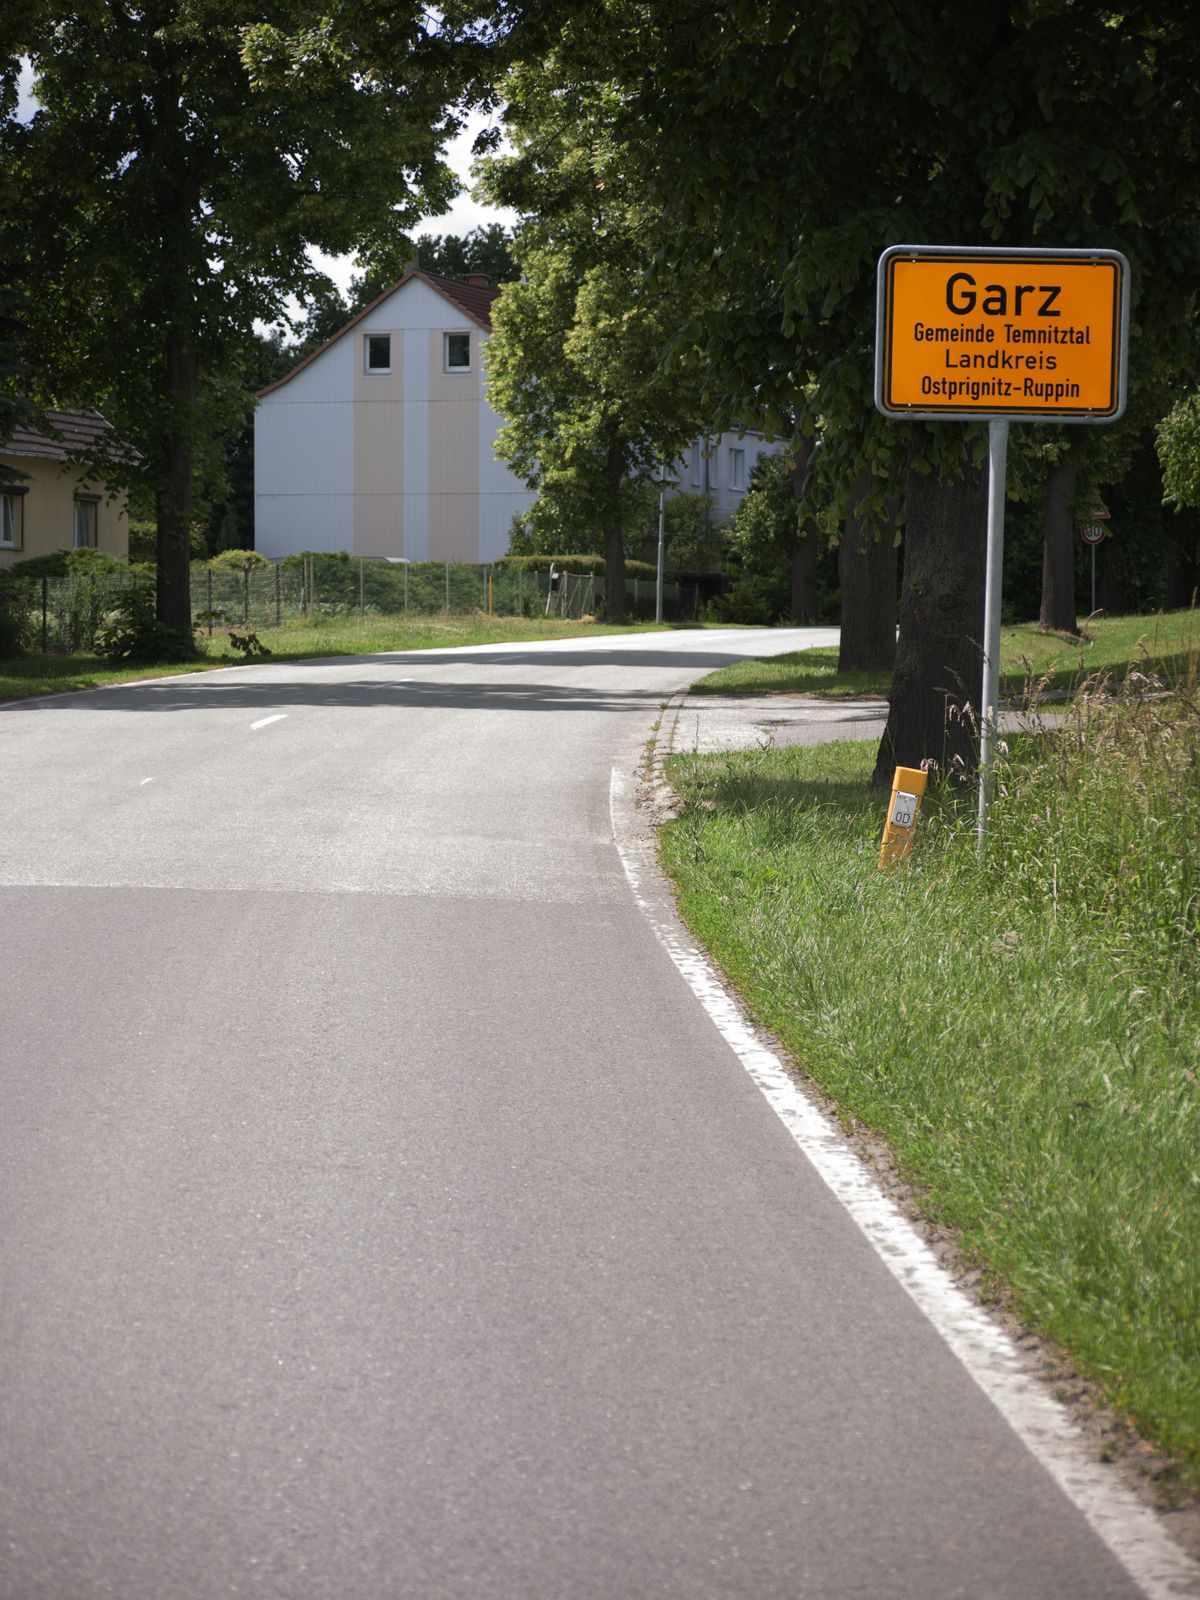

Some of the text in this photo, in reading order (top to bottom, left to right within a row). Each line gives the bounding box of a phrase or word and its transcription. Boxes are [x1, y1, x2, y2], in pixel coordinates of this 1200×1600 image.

[945, 271, 1062, 317] Garz
[913, 322, 1091, 345] Gemeinde Temnitztal
[945, 348, 1058, 370] Landkreis
[921, 375, 1081, 403] Ostprignitz-Ruppin
[896, 812, 910, 823] OD
